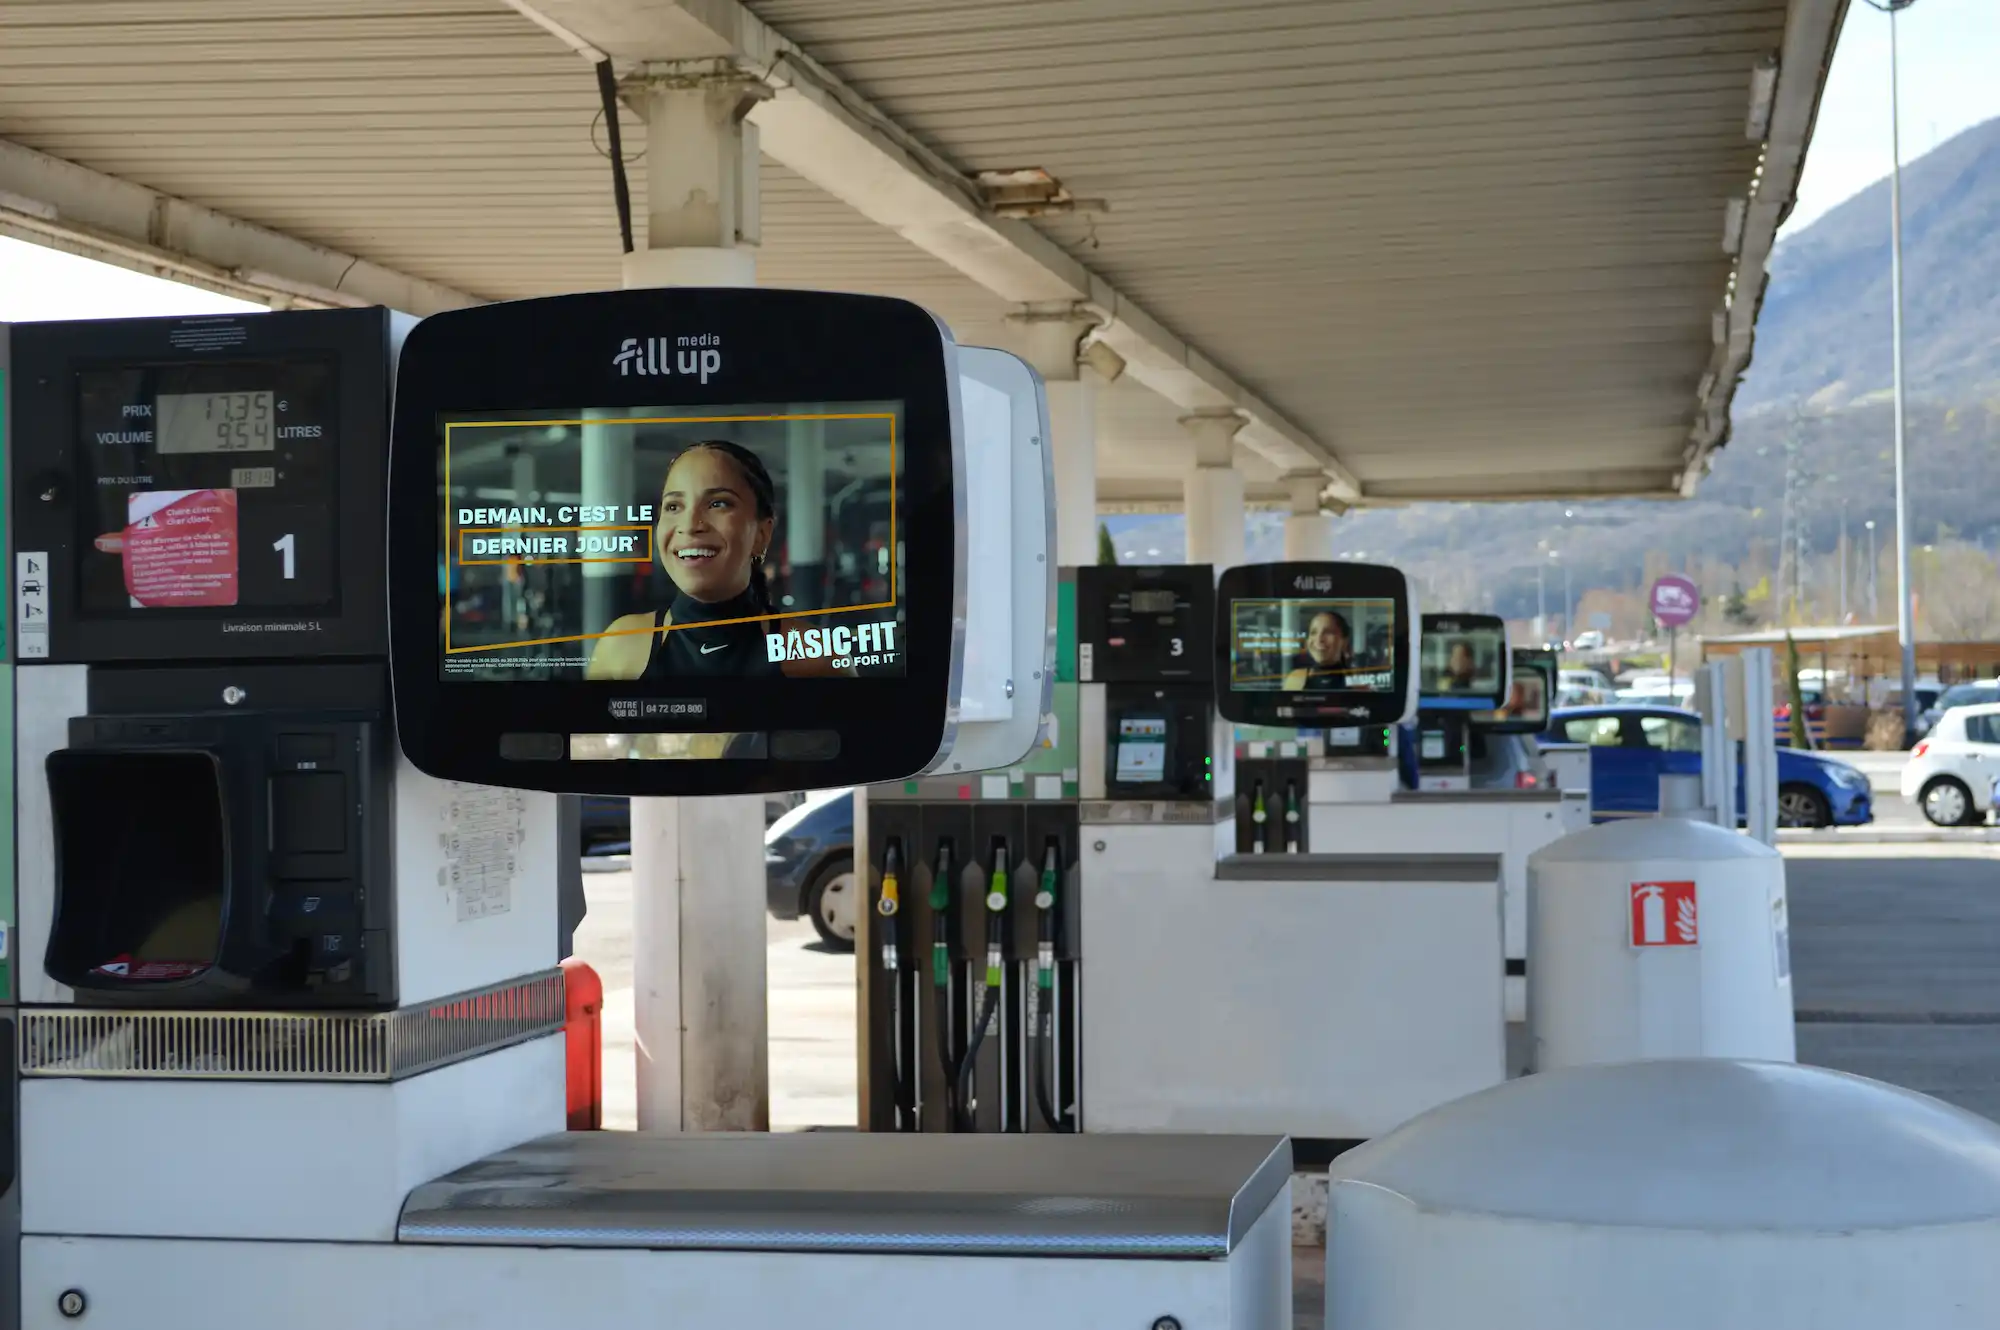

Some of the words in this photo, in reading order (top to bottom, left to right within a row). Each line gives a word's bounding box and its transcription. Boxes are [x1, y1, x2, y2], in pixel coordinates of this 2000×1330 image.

[678, 333, 720, 346] media
[613, 338, 670, 376] fill
[678, 349, 720, 384] up
[122, 404, 152, 417] PRIX
[277, 401, 288, 411] €
[97, 431, 153, 444] VOLUME
[277, 426, 322, 438] LITRES
[98, 476, 116, 485] PRIX
[118, 476, 130, 484] DU
[131, 475, 153, 484] LITRE
[459, 507, 553, 525] DEMAIN,
[558, 506, 619, 523] C'EST
[627, 505, 653, 521] LE
[472, 537, 568, 555] DERNIER
[273, 534, 294, 579] 1
[223, 622, 263, 633] Livraison
[264, 622, 306, 632] minimale
[308, 622, 315, 631] 5
[316, 621, 322, 631] L
[766, 621, 897, 662] BASIC-FIT
[1170, 638, 1183, 656] 3
[832, 658, 851, 669] GO
[854, 655, 880, 667] FOR
[611, 701, 638, 709] VOTRE
[628, 709, 638, 717] ICI
[646, 704, 657, 713] 04
[658, 704, 669, 713] 72
[687, 704, 703, 713] 800
